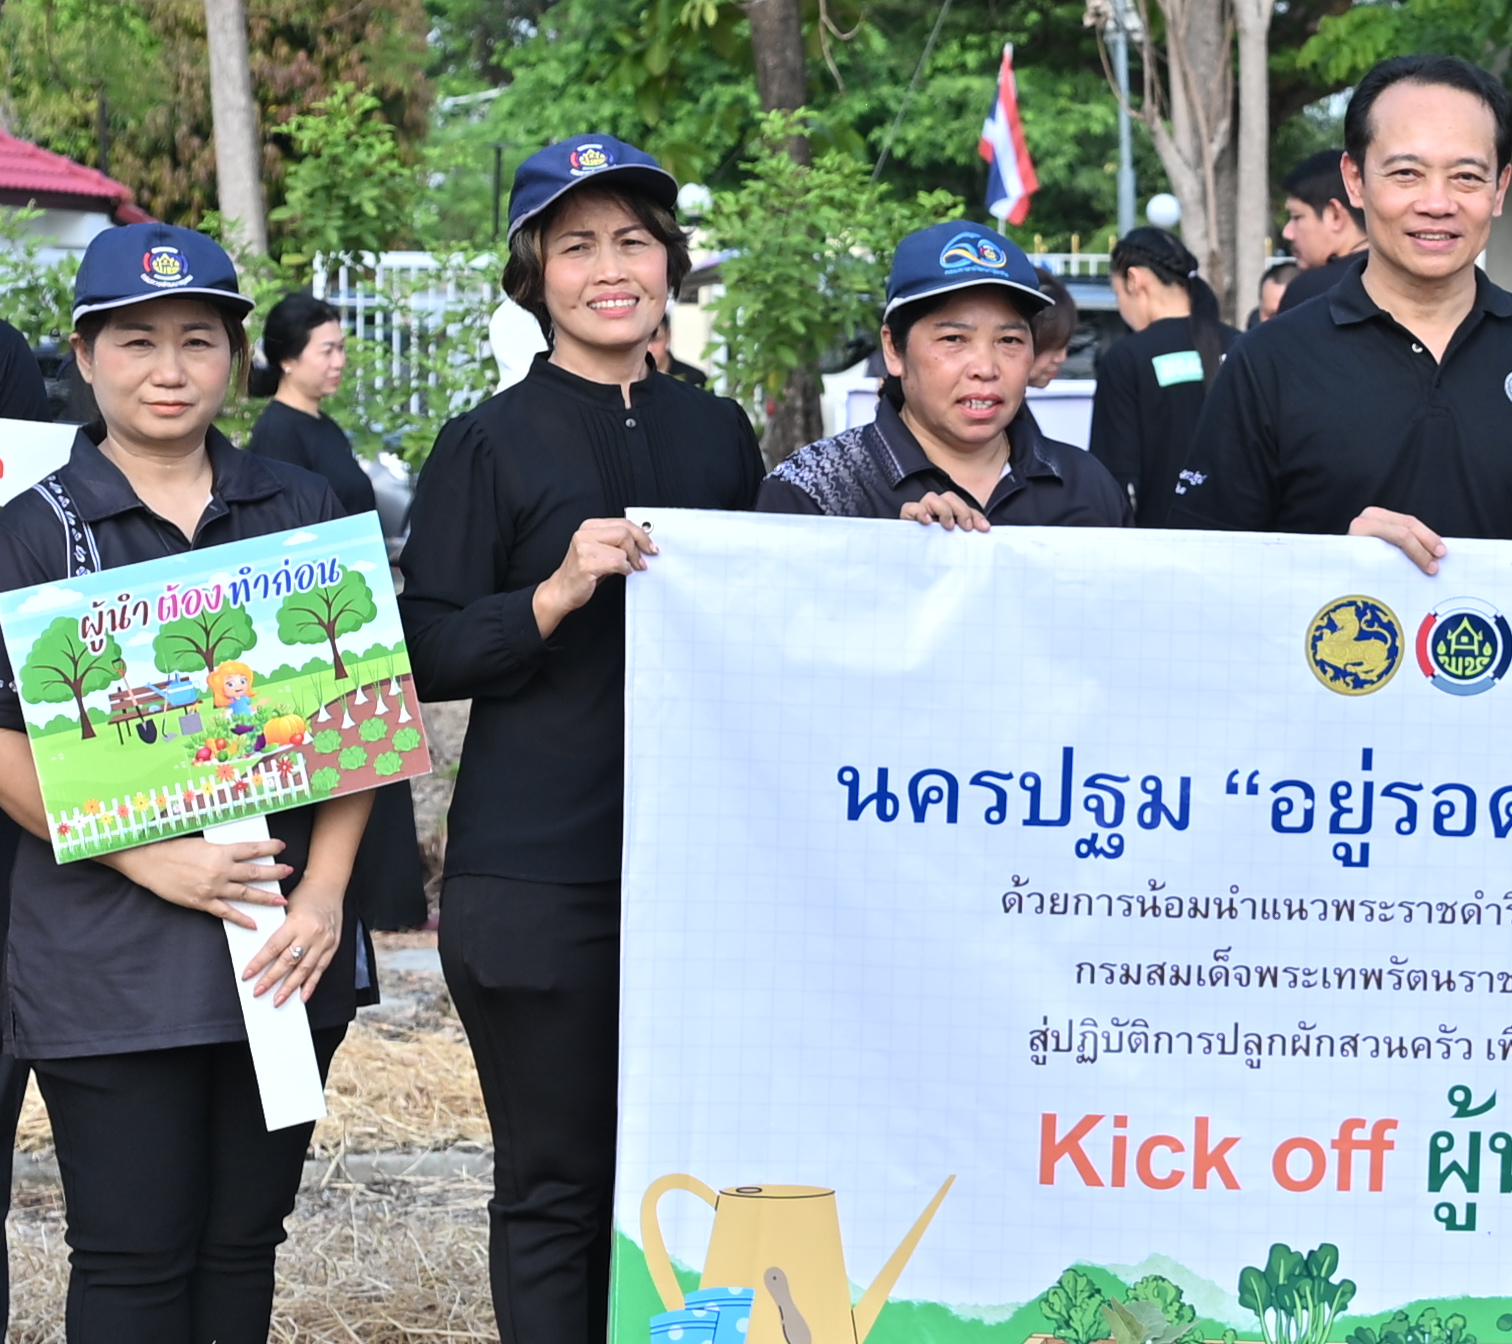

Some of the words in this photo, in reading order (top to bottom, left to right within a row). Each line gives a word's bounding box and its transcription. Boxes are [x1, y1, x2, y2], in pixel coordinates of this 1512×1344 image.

[837, 746, 1192, 859] นครปฐม
[1028, 1015, 1473, 1070] สู่ปฏิบัติการปลูกผักสวนครัว
[1038, 1112, 1242, 1191] Kick
[1271, 1117, 1399, 1193] off
